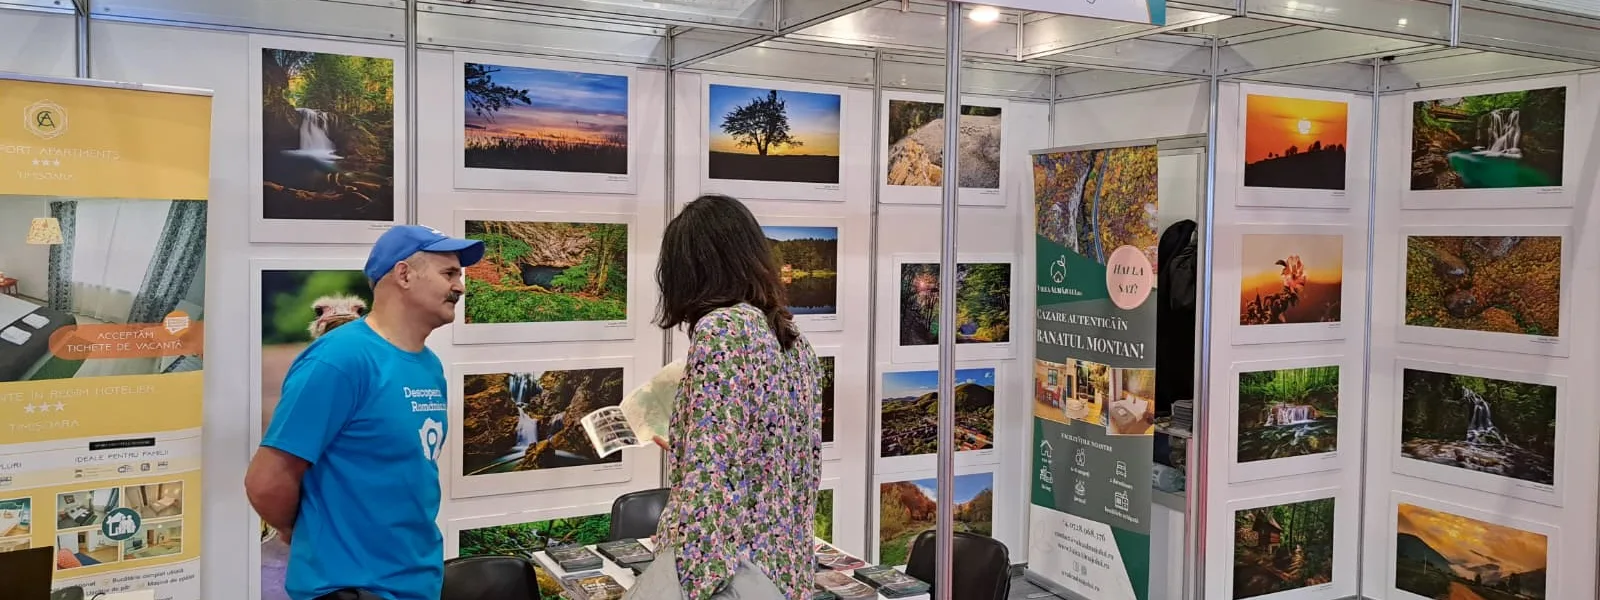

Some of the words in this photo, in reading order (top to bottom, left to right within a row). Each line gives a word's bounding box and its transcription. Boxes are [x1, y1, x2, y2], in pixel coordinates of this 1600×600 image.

[1037, 308, 1067, 323] CAZARE
[1068, 313, 1116, 330] AUTENTICĂ
[1117, 317, 1128, 331] ÎN
[97, 330, 154, 340] ACCEPTĂM
[67, 343, 112, 353] TICHETE
[117, 343, 131, 351] DE
[1037, 329, 1084, 349] BANATUL
[1086, 336, 1144, 359] MONTAN!
[108, 452, 139, 460] PENTRU
